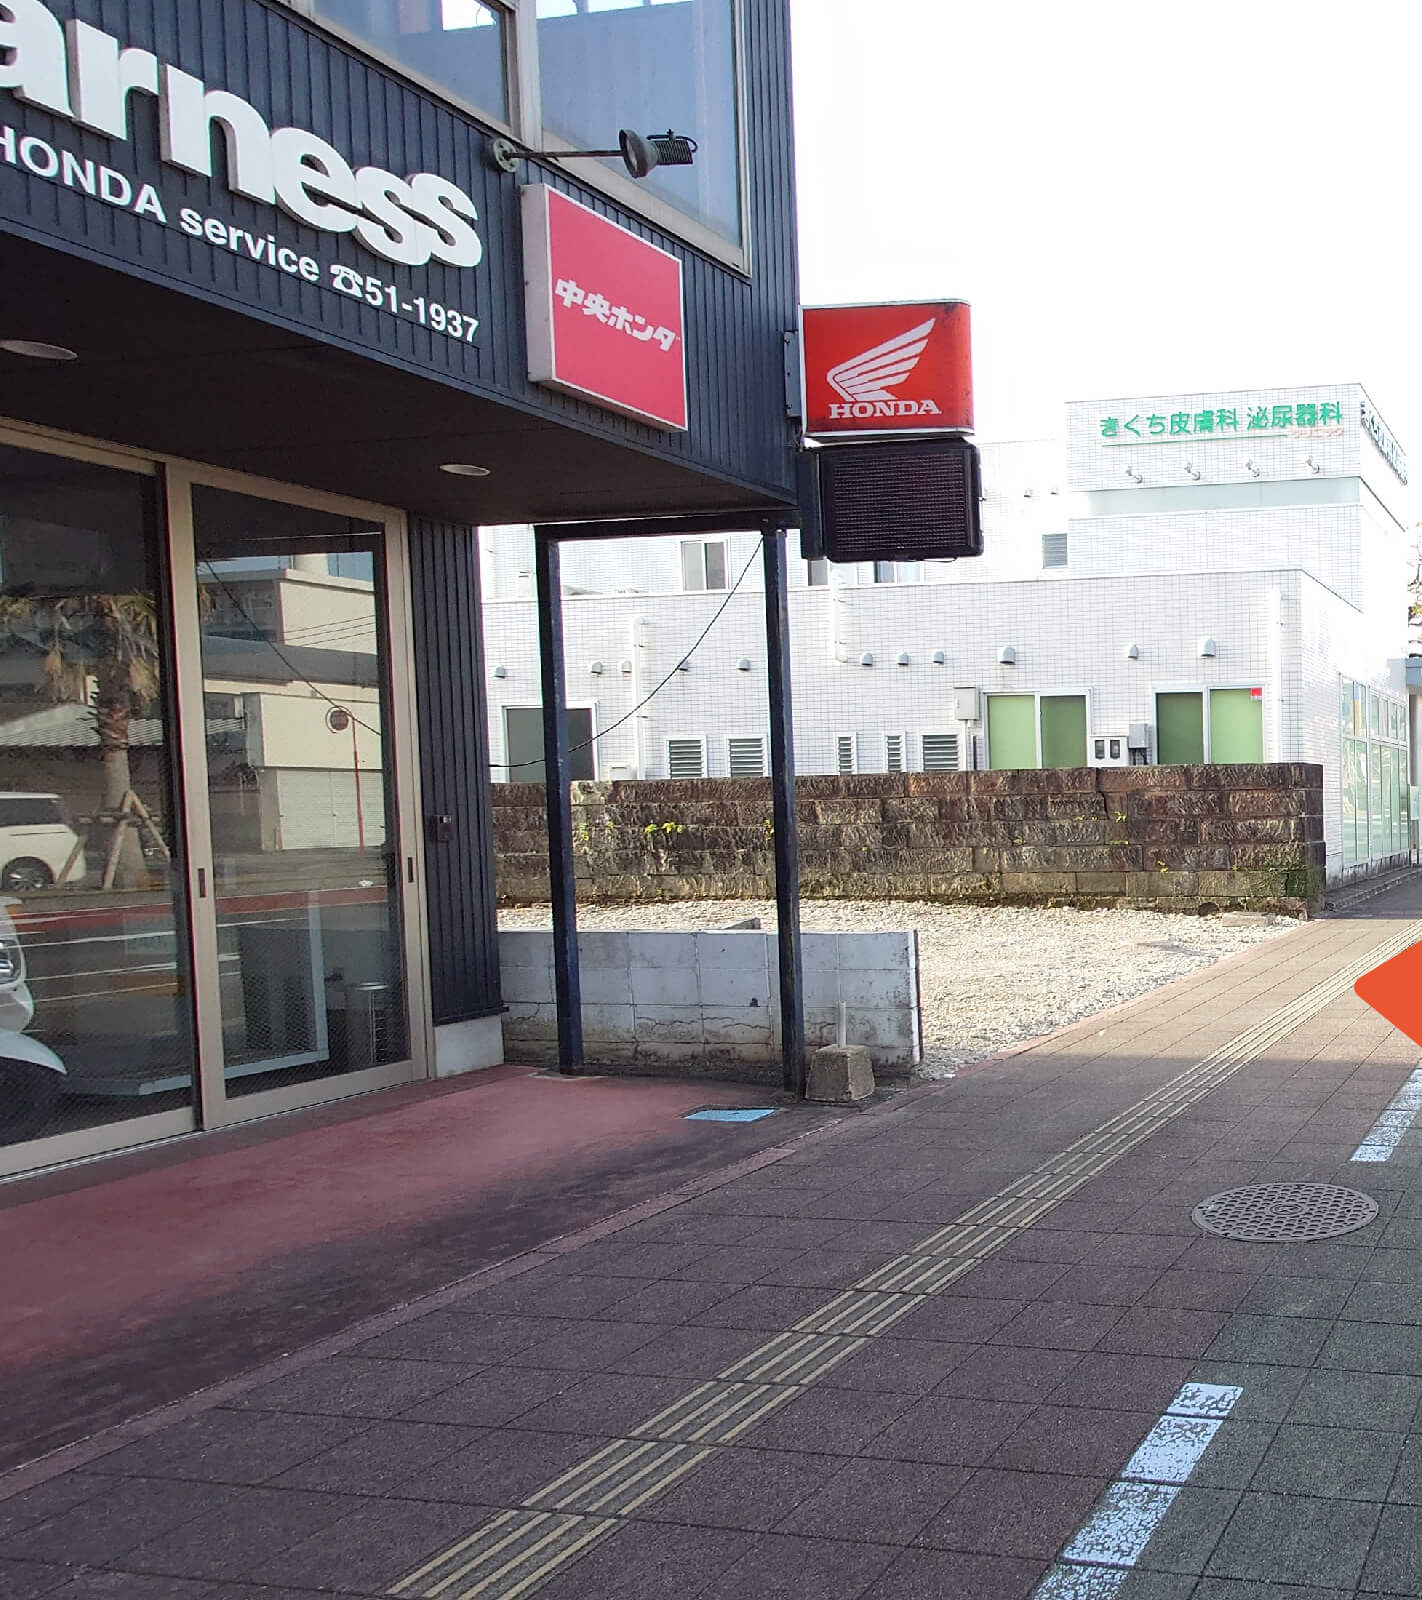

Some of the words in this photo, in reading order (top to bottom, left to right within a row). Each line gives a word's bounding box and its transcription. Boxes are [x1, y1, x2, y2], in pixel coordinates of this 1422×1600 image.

[180, 207, 320, 282] service
[828, 400, 942, 419] HONDA
[1100, 407, 1239, 437] きくち皮膚科
[1247, 401, 1343, 431] 泌尿器科
